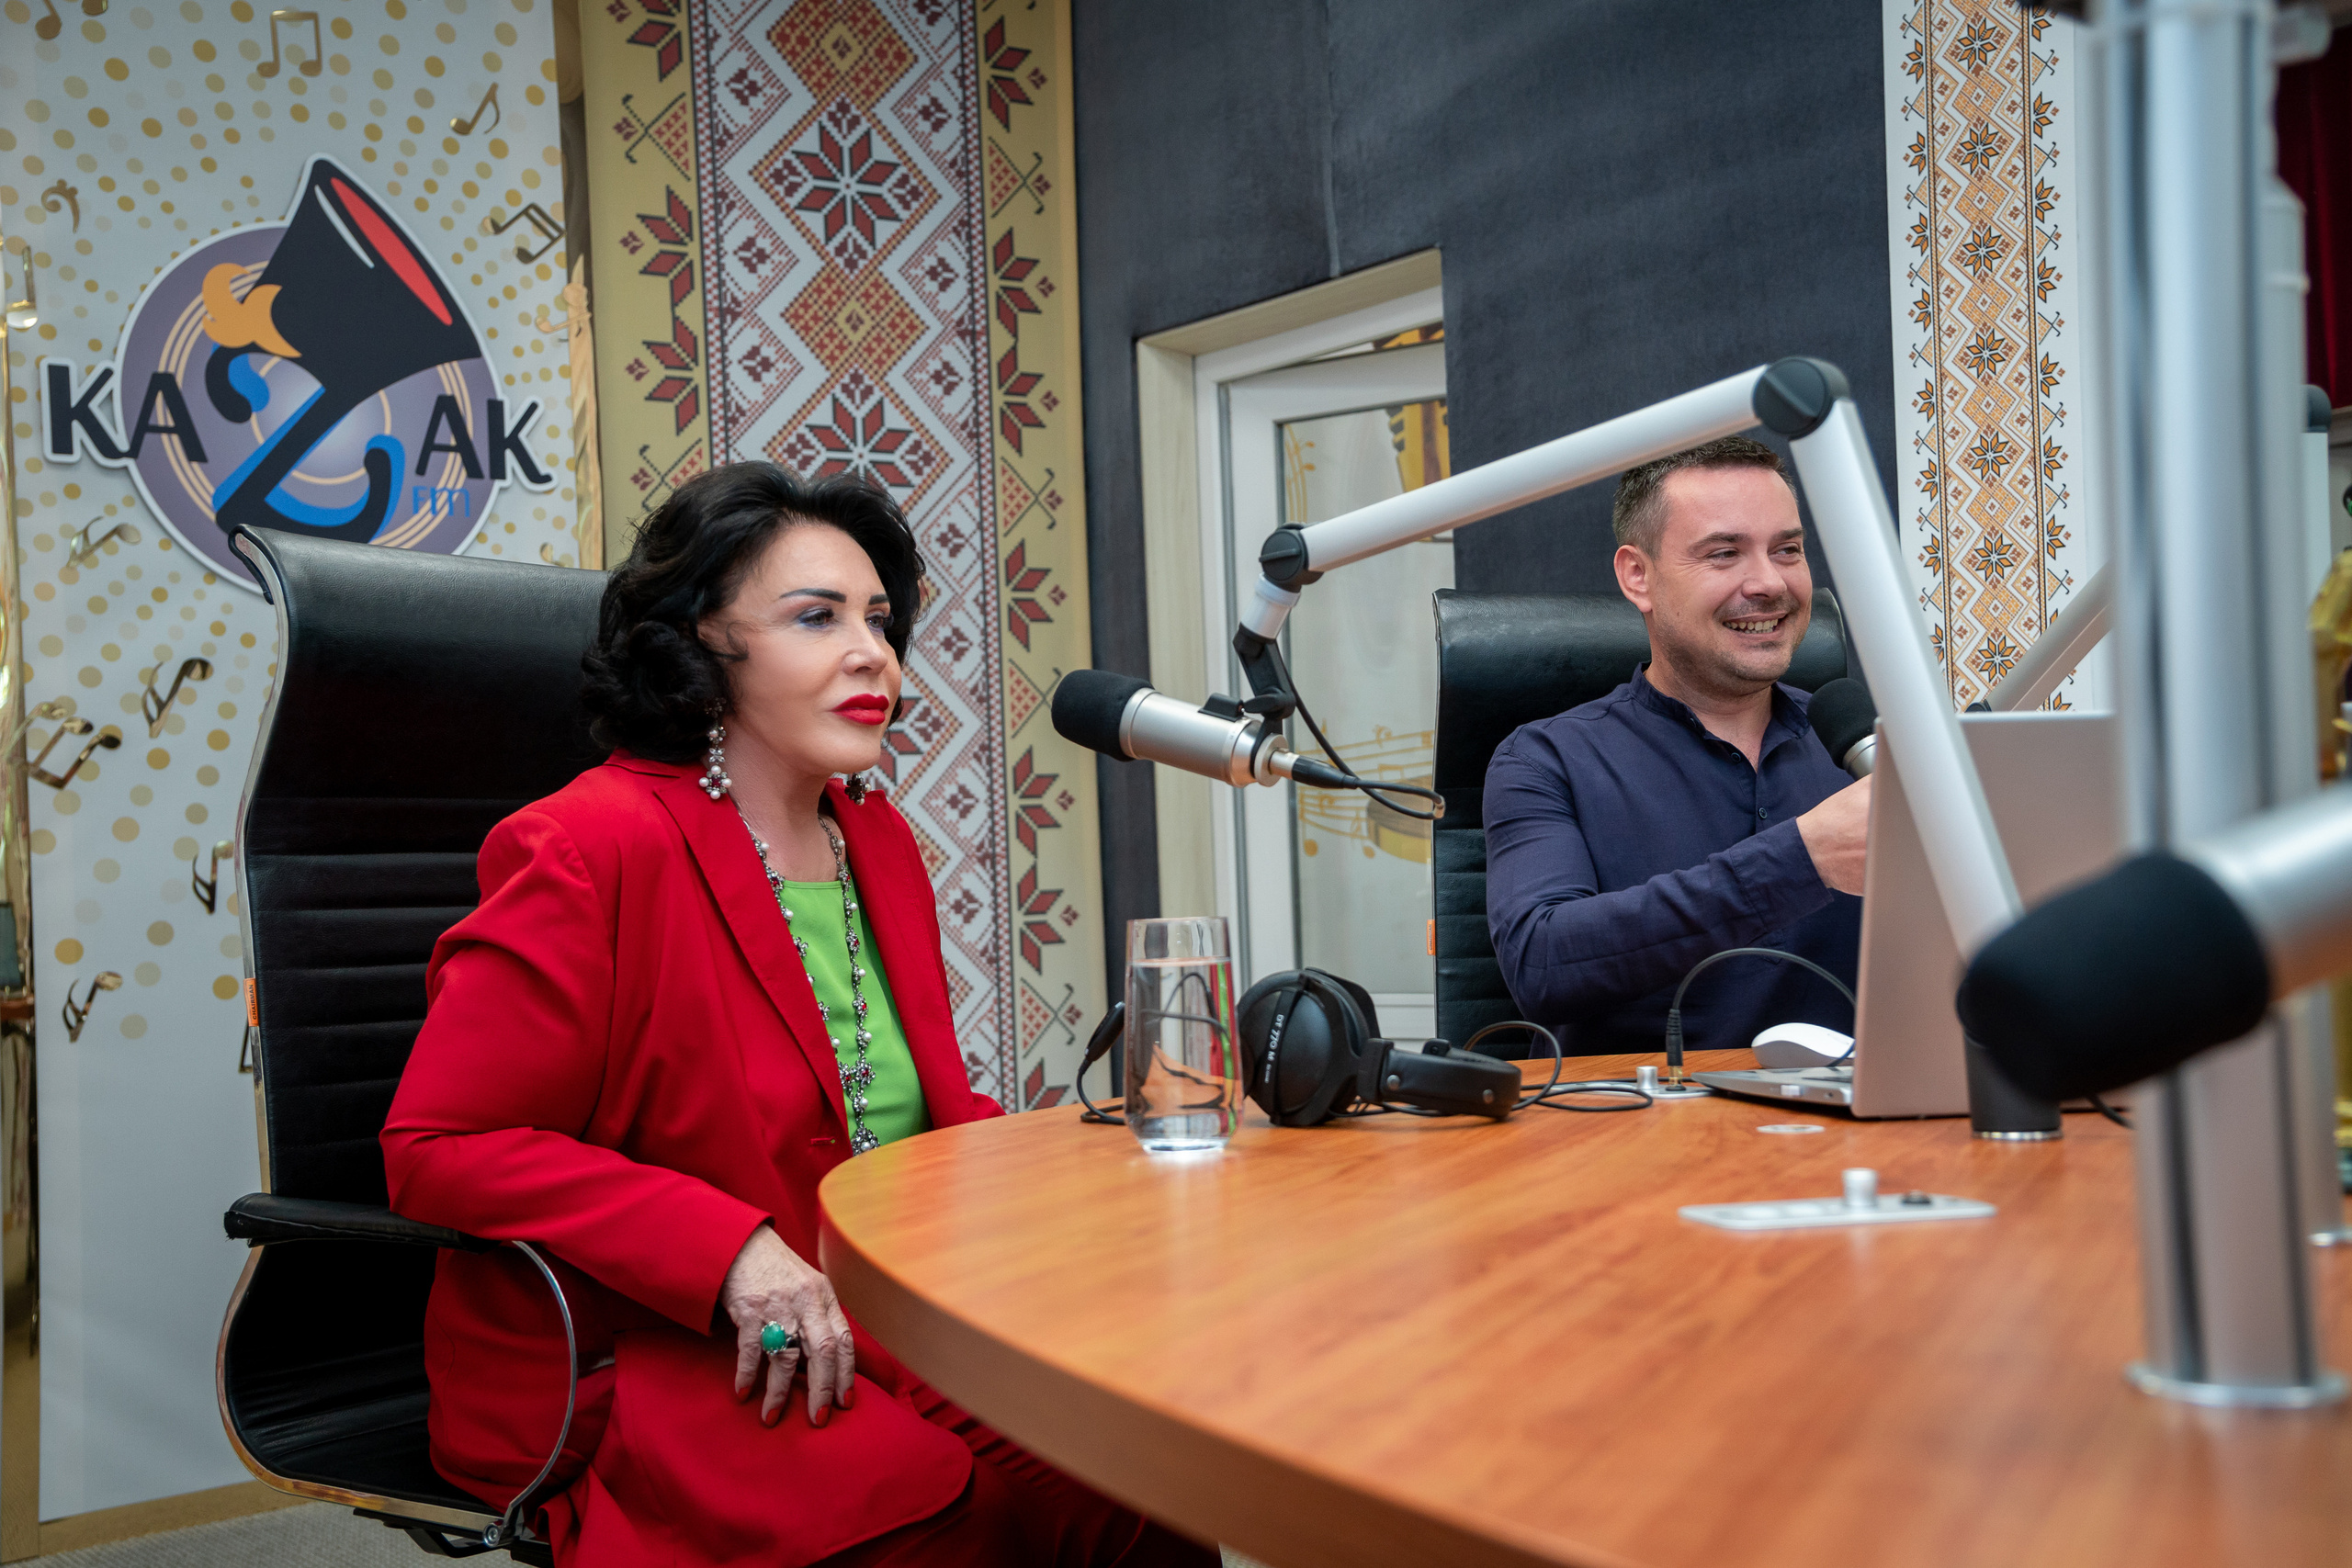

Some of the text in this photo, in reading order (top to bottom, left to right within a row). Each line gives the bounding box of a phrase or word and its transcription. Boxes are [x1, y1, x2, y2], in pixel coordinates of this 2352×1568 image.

[47, 344, 552, 544] KAZAK
[249, 984, 257, 1020] CHAIRMAN
[1275, 1013, 1285, 1028] DT
[1270, 1029, 1281, 1050] 770
[1267, 1050, 1276, 1062] M
